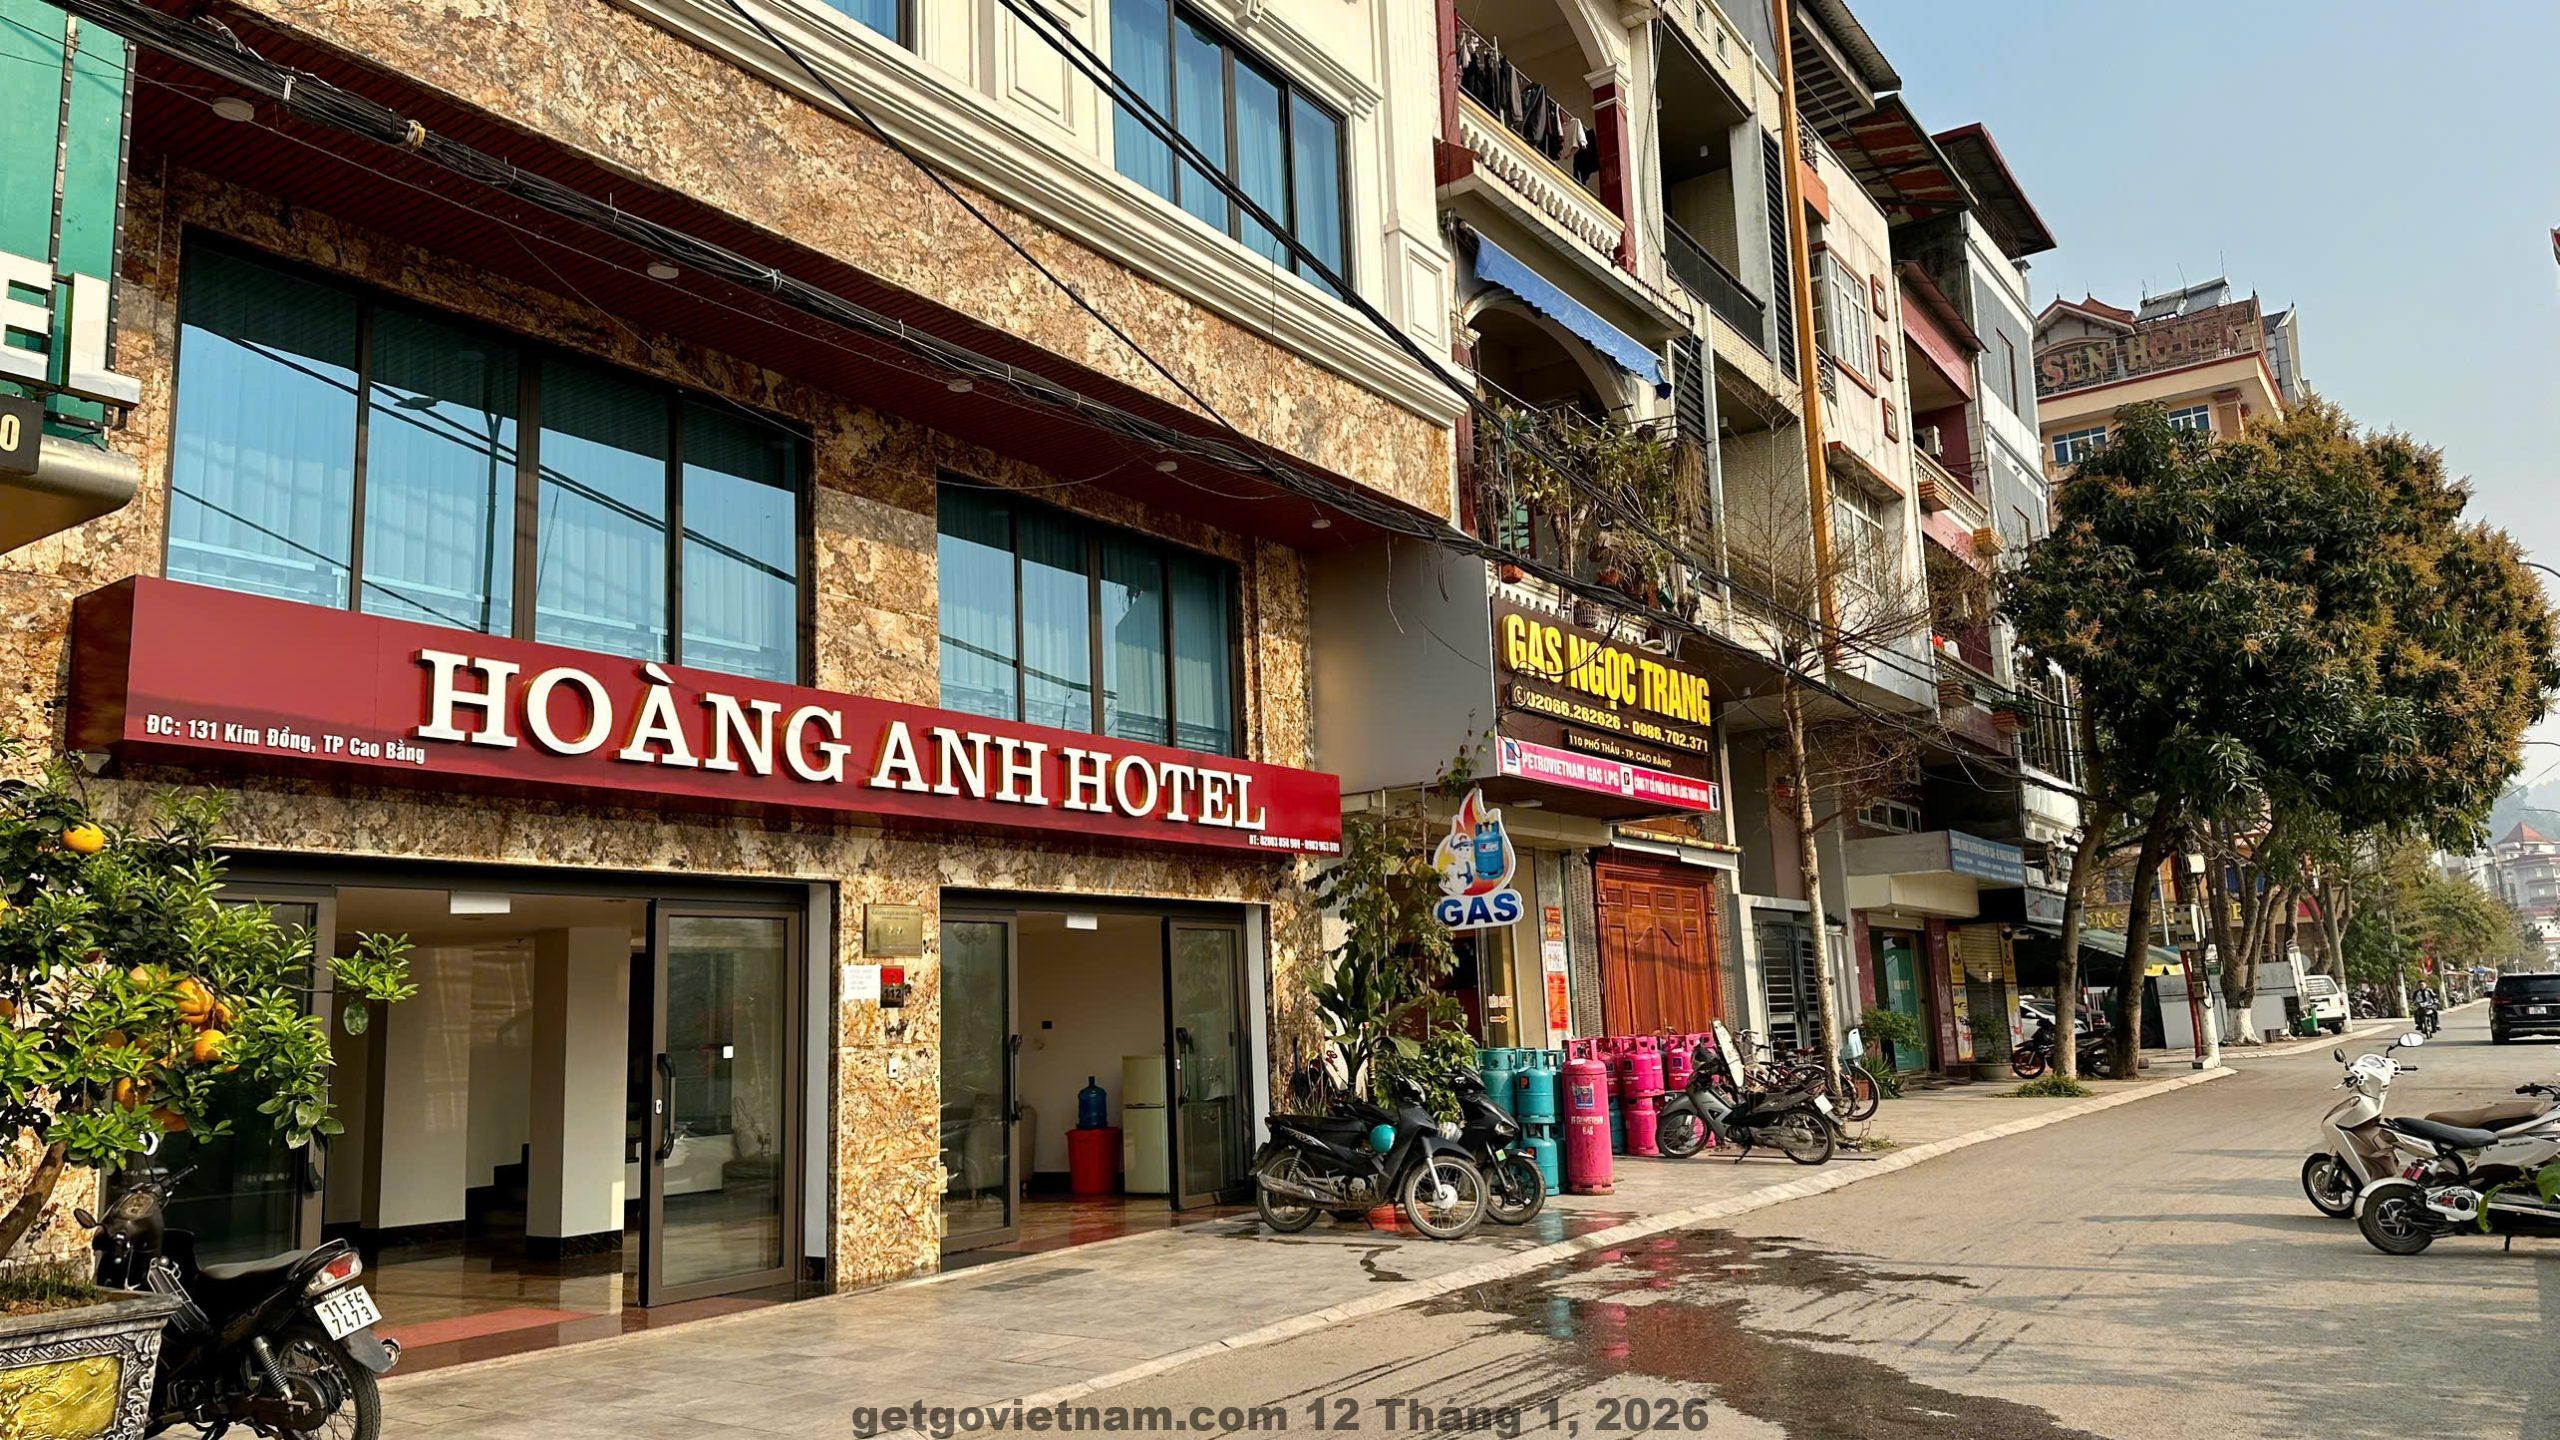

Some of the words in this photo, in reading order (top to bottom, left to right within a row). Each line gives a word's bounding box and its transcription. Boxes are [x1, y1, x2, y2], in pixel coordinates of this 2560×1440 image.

[2041, 341, 2110, 388] SEN
[1504, 613, 1564, 683] GAS
[1567, 634, 1637, 710] NGỌC
[1640, 659, 1711, 726] TRANG
[146, 714, 181, 736] ĐC:
[188, 719, 217, 740] 131
[224, 723, 259, 745] Kim
[266, 726, 316, 753] Đồng,
[323, 734, 344, 753] TP
[350, 737, 380, 758] Cao
[385, 739, 425, 765] Bằng
[413, 649, 852, 783] HOÀNG
[868, 721, 1048, 806] ANH
[1060, 746, 1266, 831] HOTEL
[1569, 735, 1582, 746] 110
[1636, 751, 1651, 763] CAO
[1632, 721, 1708, 752] 0986.702.371
[1521, 752, 1585, 780] PETROVIETNAM
[1586, 766, 1602, 783] GAS
[1604, 769, 1619, 786] LPG
[1437, 893, 1518, 927] GAS
[324, 1291, 365, 1318] 11-F4
[332, 1306, 373, 1334] 7473
